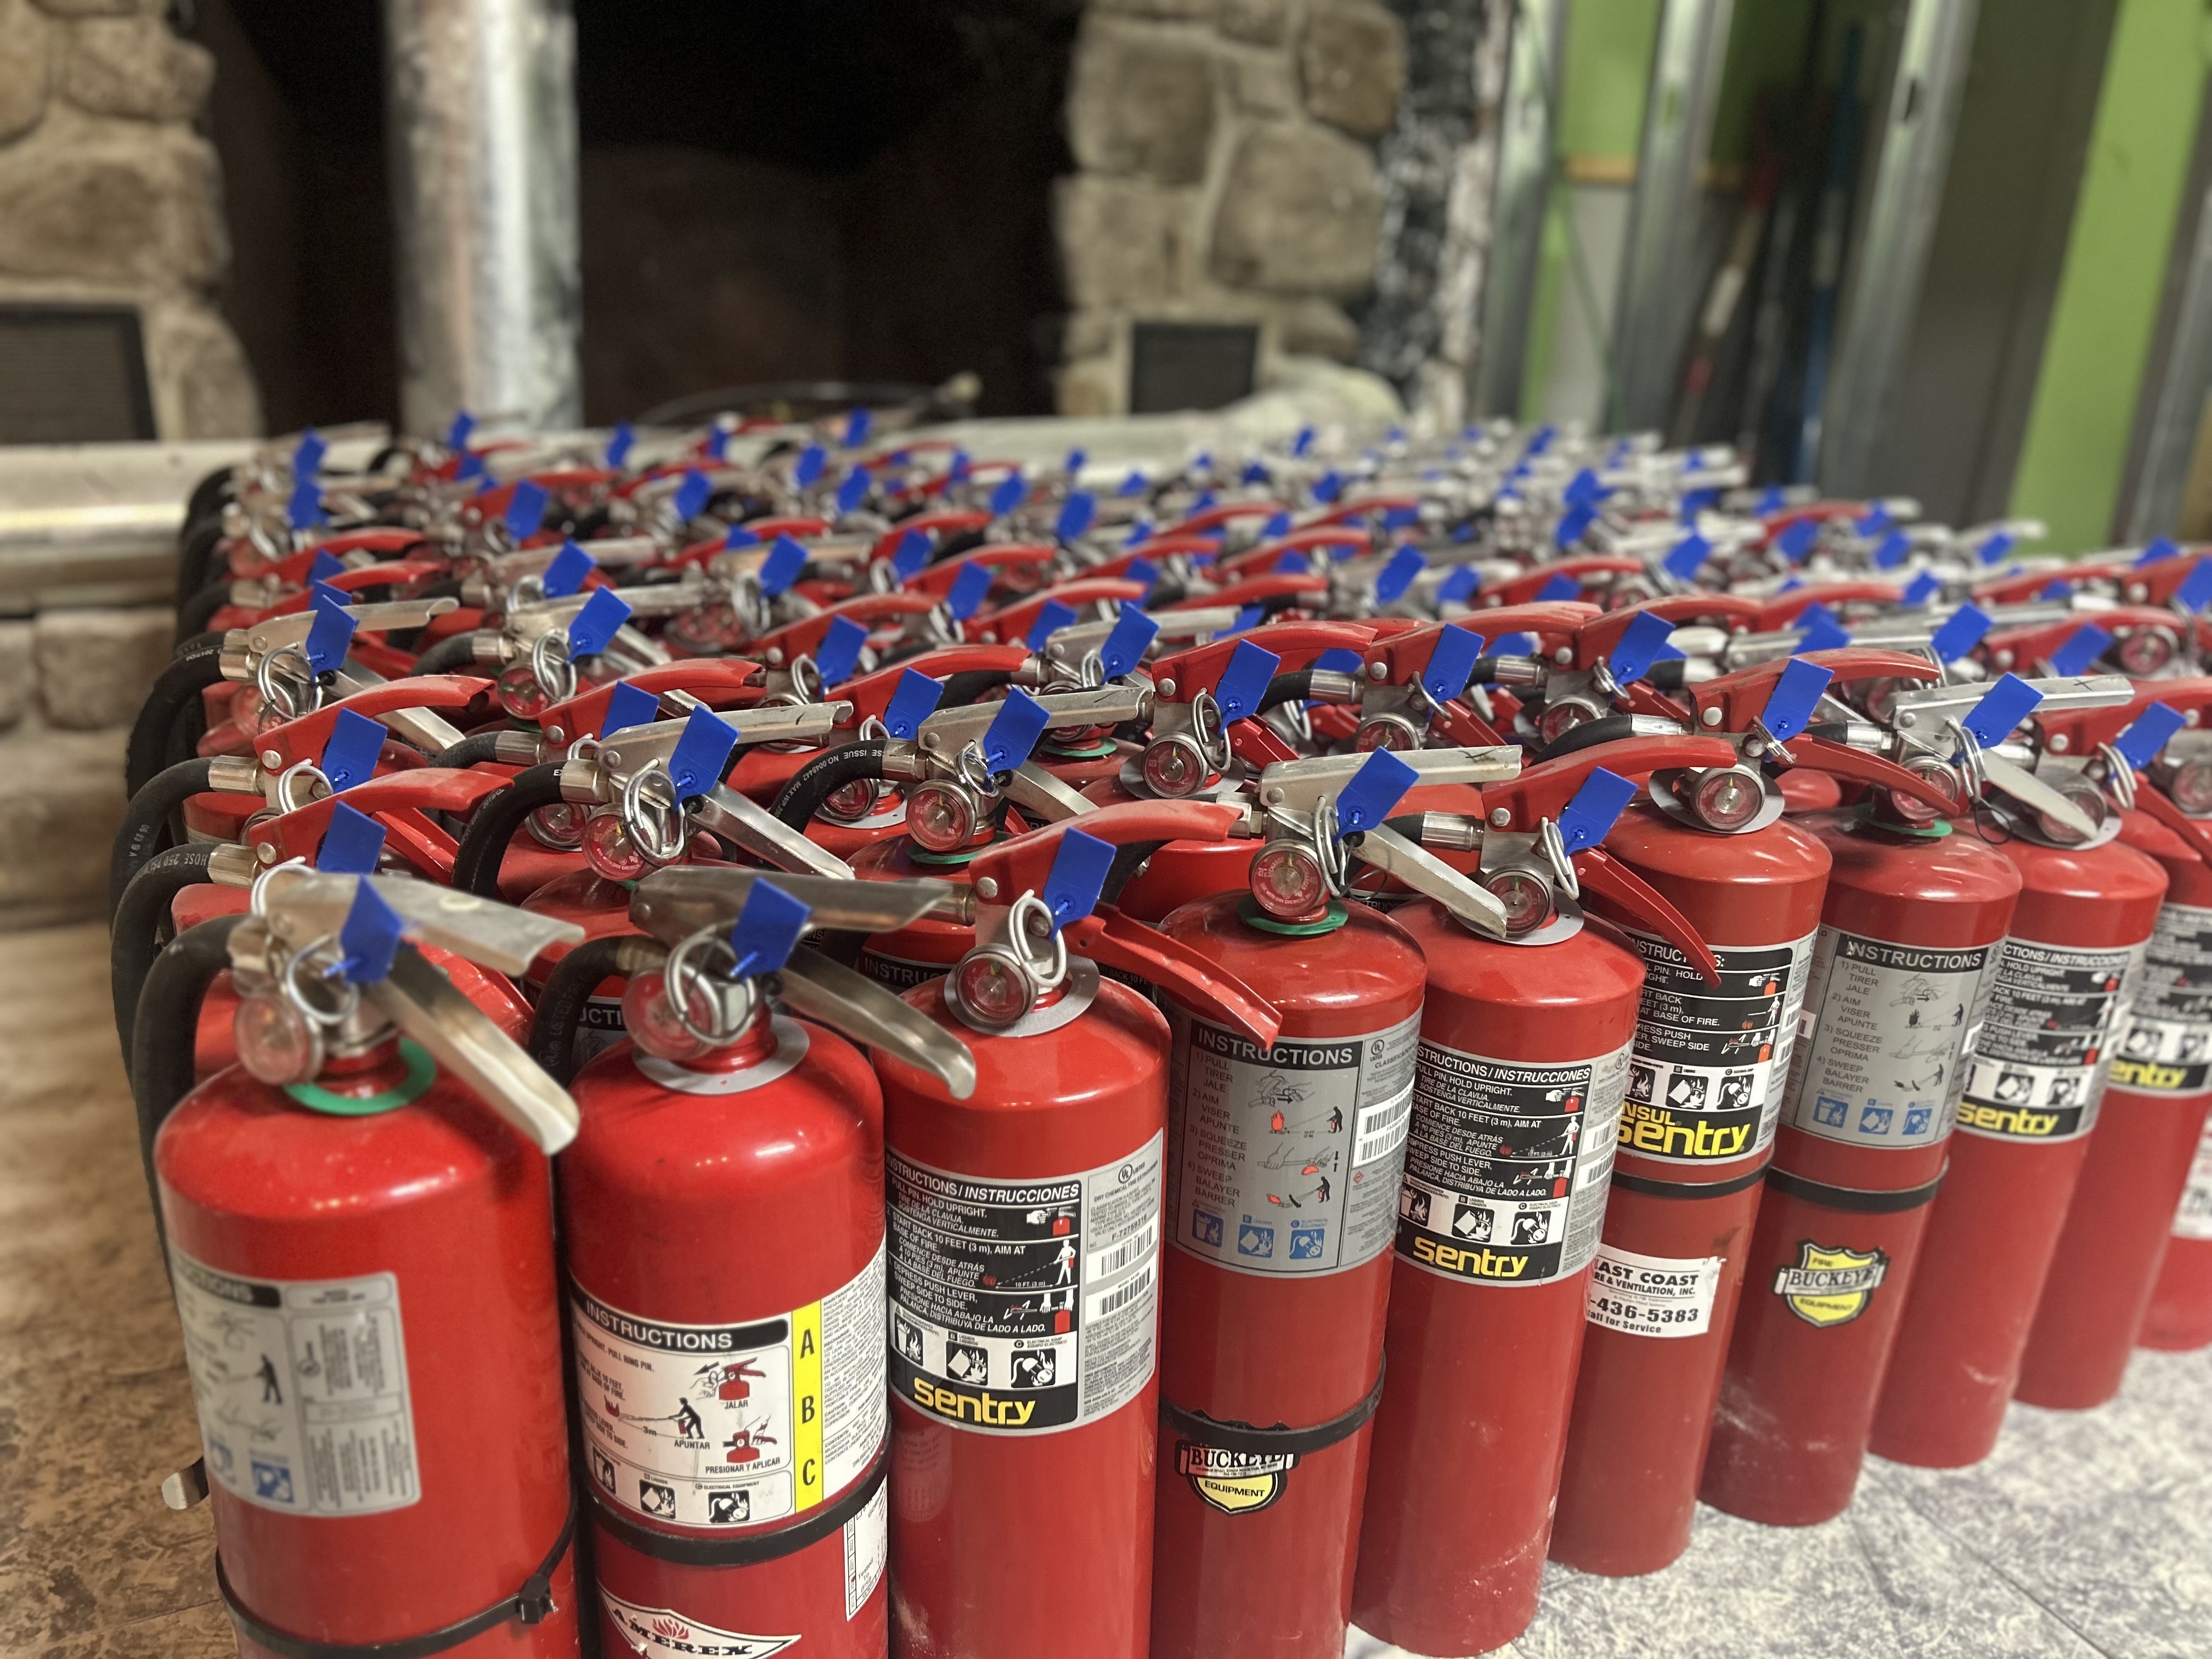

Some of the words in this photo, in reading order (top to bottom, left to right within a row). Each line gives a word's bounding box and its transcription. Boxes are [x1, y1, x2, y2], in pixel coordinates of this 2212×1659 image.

[843, 749, 867, 759] ISSUE
[184, 853, 207, 866] HOSE
[1847, 940, 1982, 969] NSTRUCTIONS
[1676, 970, 1703, 980] HOLD
[1851, 963, 1876, 977] PULL
[2007, 962, 2029, 971] HOLD
[1849, 973, 1879, 986] TIRER
[1656, 993, 1682, 1004] BACK
[1832, 992, 1840, 1003] 2)
[1842, 995, 1861, 1006] AIM
[1846, 984, 1870, 996] JALE
[1654, 1010, 1679, 1022] BASE
[1697, 1017, 1719, 1026] FIRE.
[1841, 1005, 1870, 1019] VISER
[1837, 1015, 1877, 1031] APUNTE
[1652, 1036, 1685, 1048] SWEEP
[1664, 1030, 1690, 1040] PUSH
[1824, 1024, 1833, 1035] 3)
[1835, 1028, 1882, 1045] SQUEEZE
[1199, 1029, 1353, 1066] INSTRUCTIONS
[1830, 1046, 1869, 1062] OPRIMA
[1832, 1037, 1880, 1054] PRESSER
[1206, 1056, 1229, 1071] PULL
[1816, 1054, 1825, 1066] 4)
[1828, 1059, 1863, 1072] SWEEP
[1206, 1068, 1233, 1083] TIRER
[1421, 1075, 1435, 1086] TIRE
[1436, 1082, 1446, 1092] DE
[1447, 1085, 1456, 1093] LA
[1494, 1068, 1590, 1082] INSTRUCCIONES
[1825, 1068, 1869, 1085] BALAYER
[1203, 1080, 1226, 1093] JALE
[1420, 1083, 1455, 1102] SOSTENGA
[1449, 1076, 1472, 1088] HOLD
[1475, 1082, 1513, 1096] UPRIGHT.
[1822, 1077, 1863, 1093] BARRER
[1193, 1088, 1201, 1100] 2)
[1203, 1092, 1219, 1105] AIM
[1202, 1104, 1230, 1120] VISER
[1430, 1110, 1440, 1119] OF
[1442, 1114, 1461, 1127] FIRE.
[1434, 1103, 1456, 1116] BACK
[1469, 1113, 1490, 1124] FEET
[1491, 1117, 1498, 1126] (3
[1956, 1102, 2059, 1135] sentry
[1199, 1116, 1239, 1135] APUNTE
[1190, 1125, 1198, 1137] 3)
[1200, 1129, 1247, 1150] SQUEEZE
[1199, 1139, 1245, 1162] PRESSER
[1198, 1151, 1236, 1171] OPRIMA
[1430, 1156, 1447, 1168] SIDE
[1449, 1163, 1459, 1171] TO
[1462, 1165, 1481, 1177] SIDE.
[1440, 1150, 1462, 1163] PUSH
[1464, 1157, 1492, 1170] LEVER,
[887, 1152, 957, 1195] INSTRUCTIONS
[964, 1184, 1079, 1203] INSTRUCCIONES
[1187, 1161, 1195, 1173] 4)
[1197, 1165, 1232, 1183] SWEEP
[1196, 1175, 1240, 1198] BALAYER
[1442, 1176, 1483, 1193] DISTRIBUYA
[1494, 1187, 1517, 1196] LADO
[1526, 1188, 1547, 1197] LADO.
[892, 1177, 907, 1193] PULL
[923, 1194, 944, 1209] HOLD
[946, 1203, 987, 1218] UPRIGHT.
[1195, 1187, 1235, 1207] BARRER
[898, 1201, 931, 1223] SOSTENGA
[912, 1200, 921, 1210] DE
[922, 1204, 930, 1214] LA
[893, 1211, 911, 1229] START
[913, 1224, 933, 1240] BACK
[935, 1234, 943, 1244] 10
[945, 1237, 967, 1250] FEET
[969, 1242, 977, 1253] (3
[994, 1245, 1011, 1254] AIM
[1014, 1245, 1026, 1254] AT
[893, 1221, 909, 1239] BASE
[910, 1233, 919, 1243] OF
[921, 1238, 939, 1252] FIRE.
[1413, 1236, 1528, 1278] sentry
[1813, 1257, 1833, 1267] FIRE
[894, 1261, 923, 1285] DEPRESS
[924, 1279, 945, 1295] PUSH
[947, 1288, 978, 1304] LEVER,
[1596, 1262, 1634, 1279] AST
[1640, 1273, 1699, 1286] COAST
[1789, 1267, 1876, 1287] BUCKEYE
[894, 1271, 915, 1290] SWEEP
[916, 1285, 933, 1300] SIDE
[934, 1293, 945, 1304] TO
[946, 1297, 968, 1310] SIDE.
[1606, 1274, 1613, 1284] &
[1616, 1278, 1675, 1296] VENTILATION,
[1800, 1298, 1854, 1311] EQUIPMENT
[586, 1299, 732, 1349] INSTRUCTIONS
[1606, 1316, 1621, 1327] for
[1623, 1321, 1661, 1333] Service
[799, 1328, 815, 1359] A
[608, 1347, 622, 1361] PULL
[724, 1400, 748, 1410] JALAR
[802, 1395, 815, 1424] B
[914, 1377, 1036, 1425] sentry
[643, 1426, 657, 1436] 3m
[674, 1439, 710, 1450] APUNTAR
[705, 1464, 744, 1475] PRESIONAR
[745, 1463, 751, 1471] Y
[752, 1457, 781, 1470] APLICAR
[802, 1458, 816, 1486] C
[1205, 1480, 1265, 1497] EQUIPMENT
[613, 1608, 753, 1656] AMEREX
